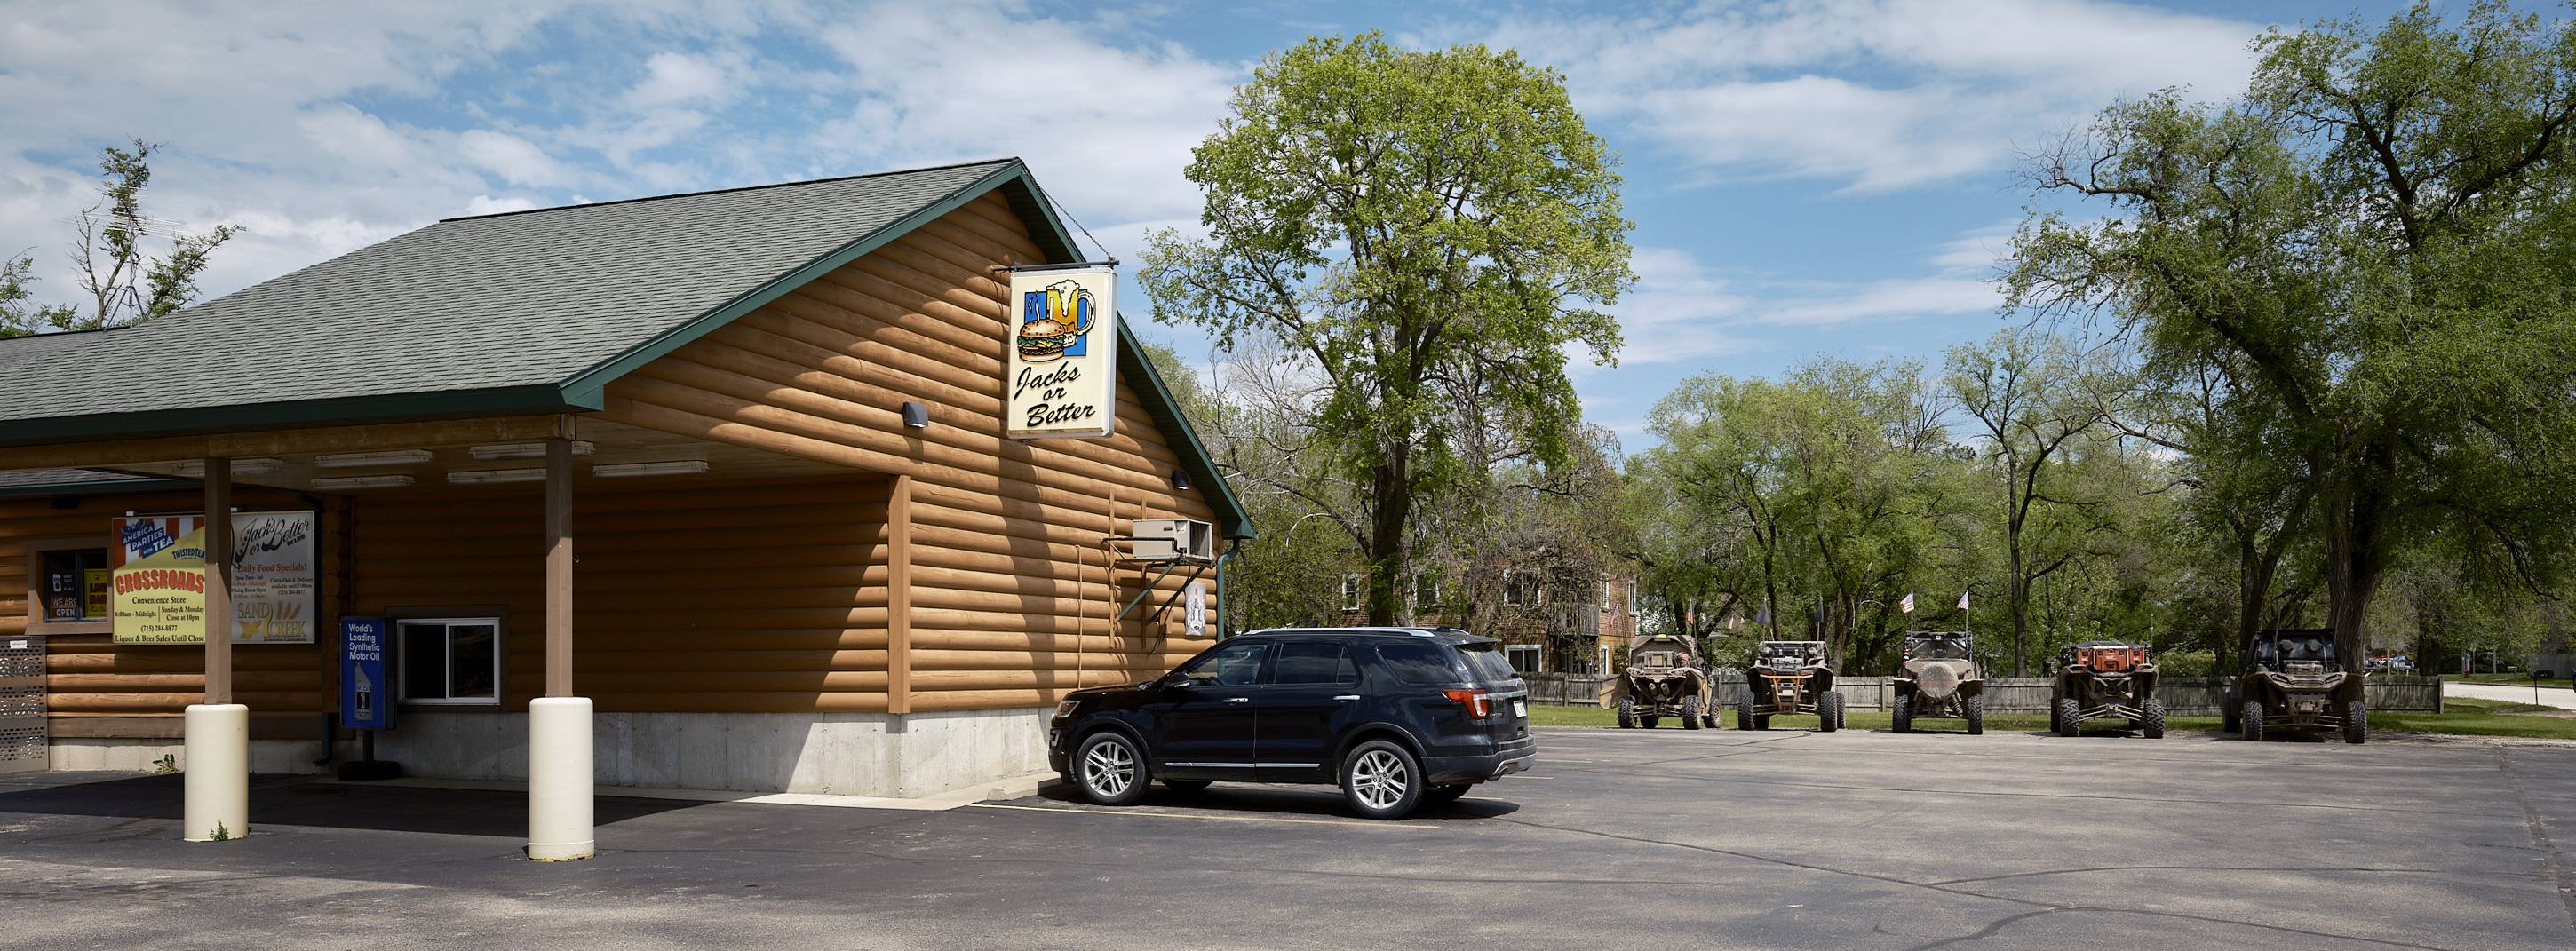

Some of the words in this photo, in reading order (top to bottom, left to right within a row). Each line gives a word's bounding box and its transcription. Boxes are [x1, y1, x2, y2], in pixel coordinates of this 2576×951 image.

[1014, 361, 1081, 401] Jacks
[1043, 387, 1067, 402] or
[1027, 402, 1096, 427] Better
[122, 526, 154, 544] AMERICA
[132, 529, 163, 550] PARTIES
[235, 518, 275, 563] Jack's
[261, 519, 310, 551] Better
[153, 535, 174, 551] TEA
[250, 543, 260, 555] or
[171, 548, 195, 559] TWISTED
[195, 548, 205, 559] TEA
[276, 561, 307, 573] Specials!
[115, 569, 205, 595] CROSSROADS
[237, 603, 269, 618] SAND
[269, 621, 306, 637] CREEK
[348, 623, 373, 632] World's
[349, 633, 376, 643] Leading
[349, 642, 380, 653] Synthetic
[370, 652, 380, 661] Oil
